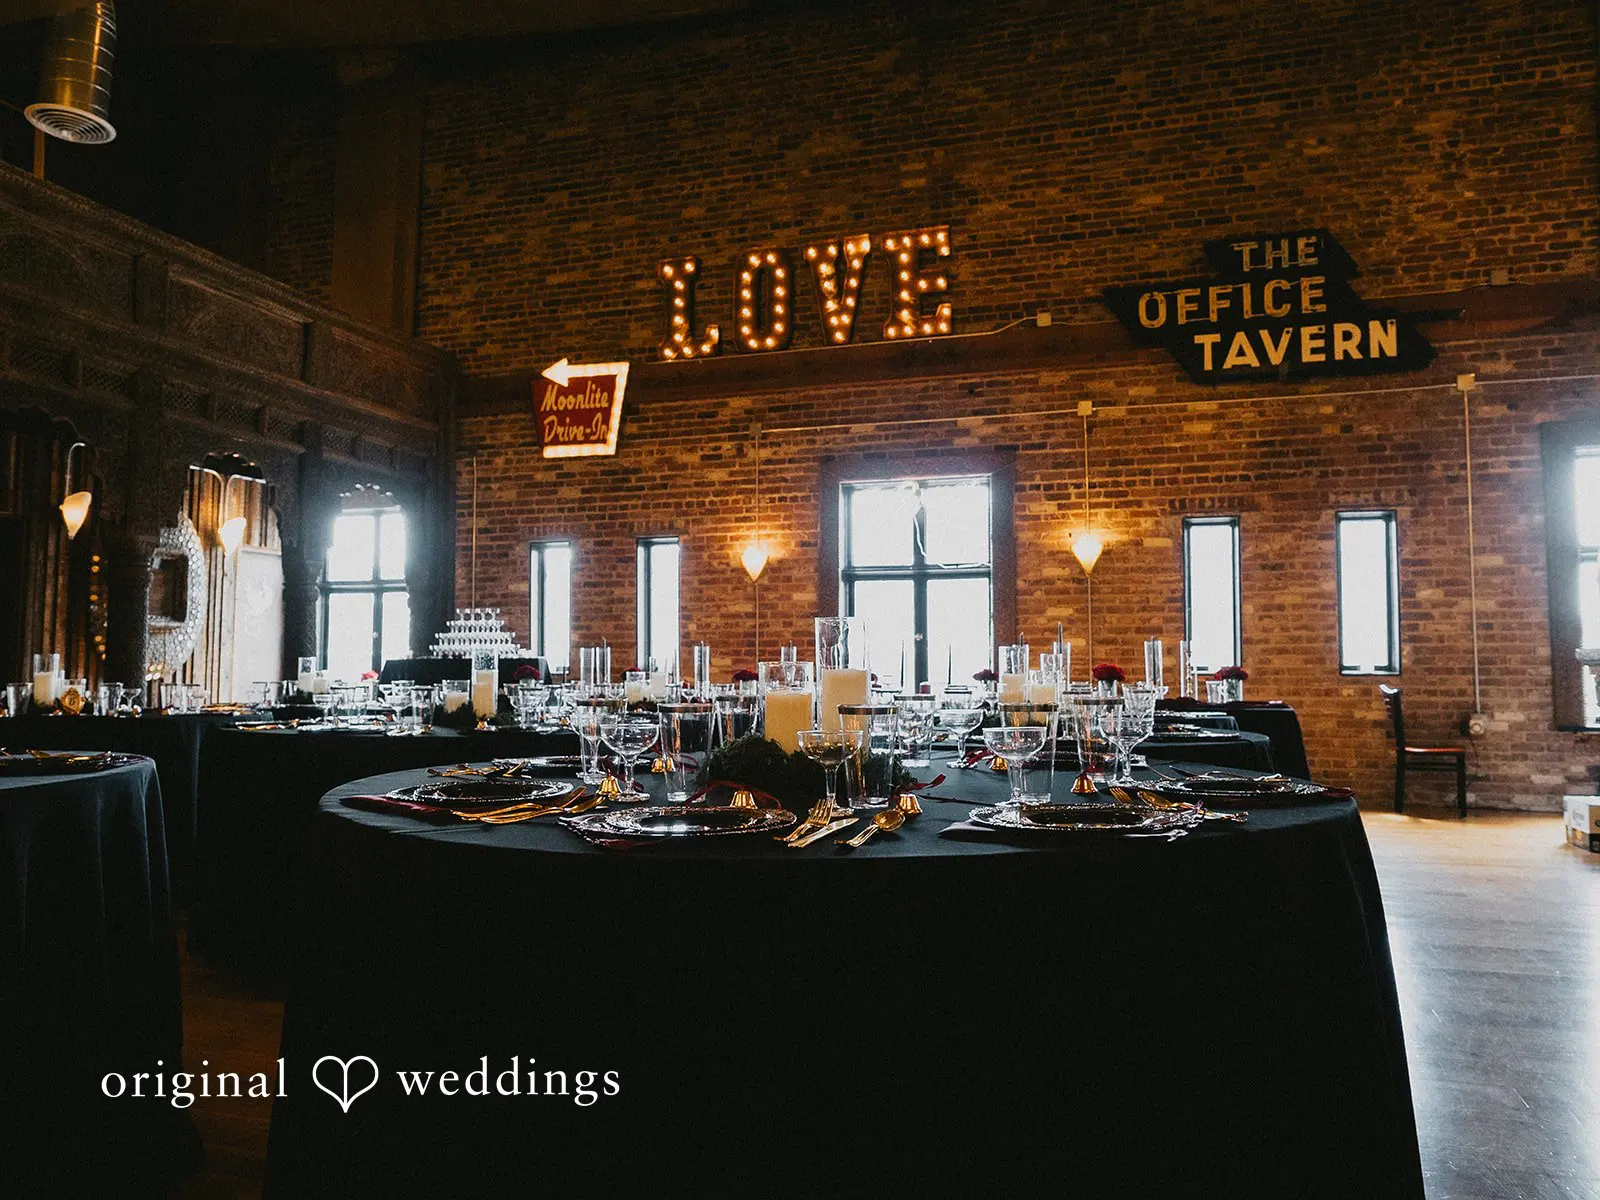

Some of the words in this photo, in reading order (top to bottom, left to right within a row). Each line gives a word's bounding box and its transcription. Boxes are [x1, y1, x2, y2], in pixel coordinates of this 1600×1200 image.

[1228, 235, 1319, 272] THE
[657, 226, 951, 361] LOVE
[1138, 276, 1327, 328] OFFICE
[1194, 318, 1398, 371] TAVERN
[540, 381, 610, 412] Moonlite
[543, 412, 612, 443] Drive-In
